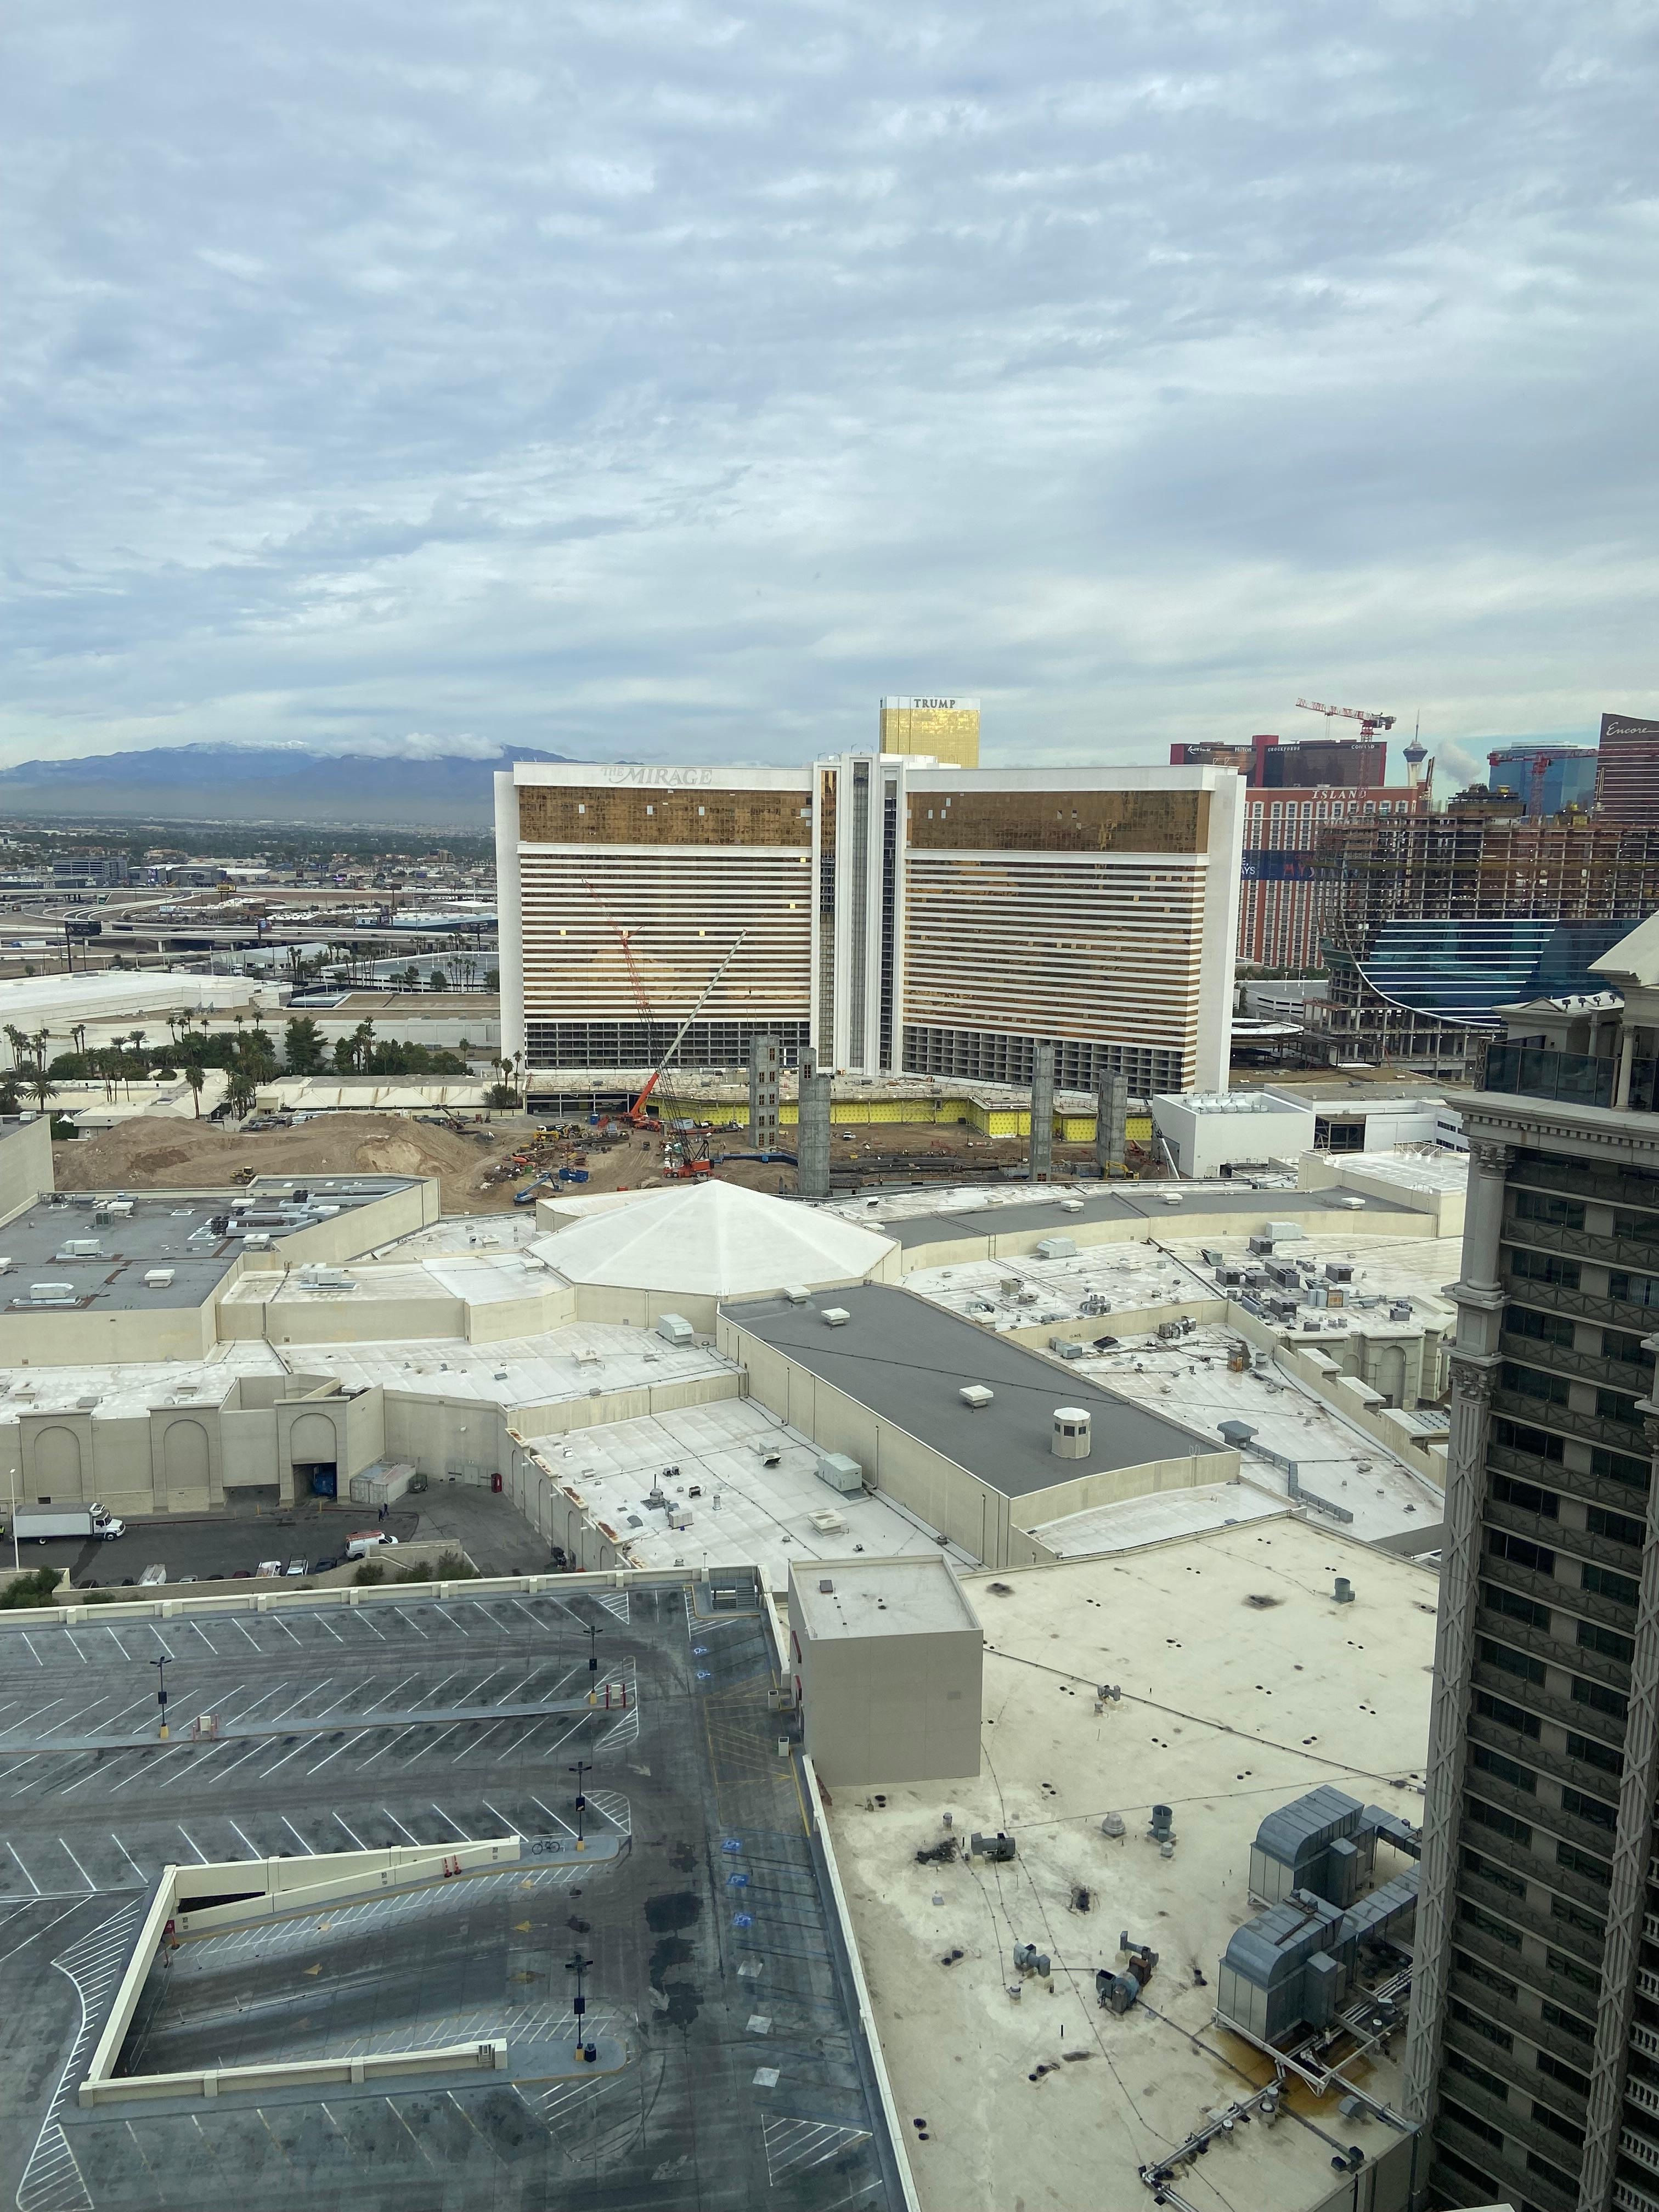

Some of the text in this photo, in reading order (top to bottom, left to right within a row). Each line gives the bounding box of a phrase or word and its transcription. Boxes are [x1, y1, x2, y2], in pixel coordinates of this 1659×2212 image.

[914, 699, 956, 708] TRUMP
[1606, 721, 1649, 736] Encore
[601, 767, 713, 787] THE MIRAGE
[1311, 790, 1367, 799] ISLAND
